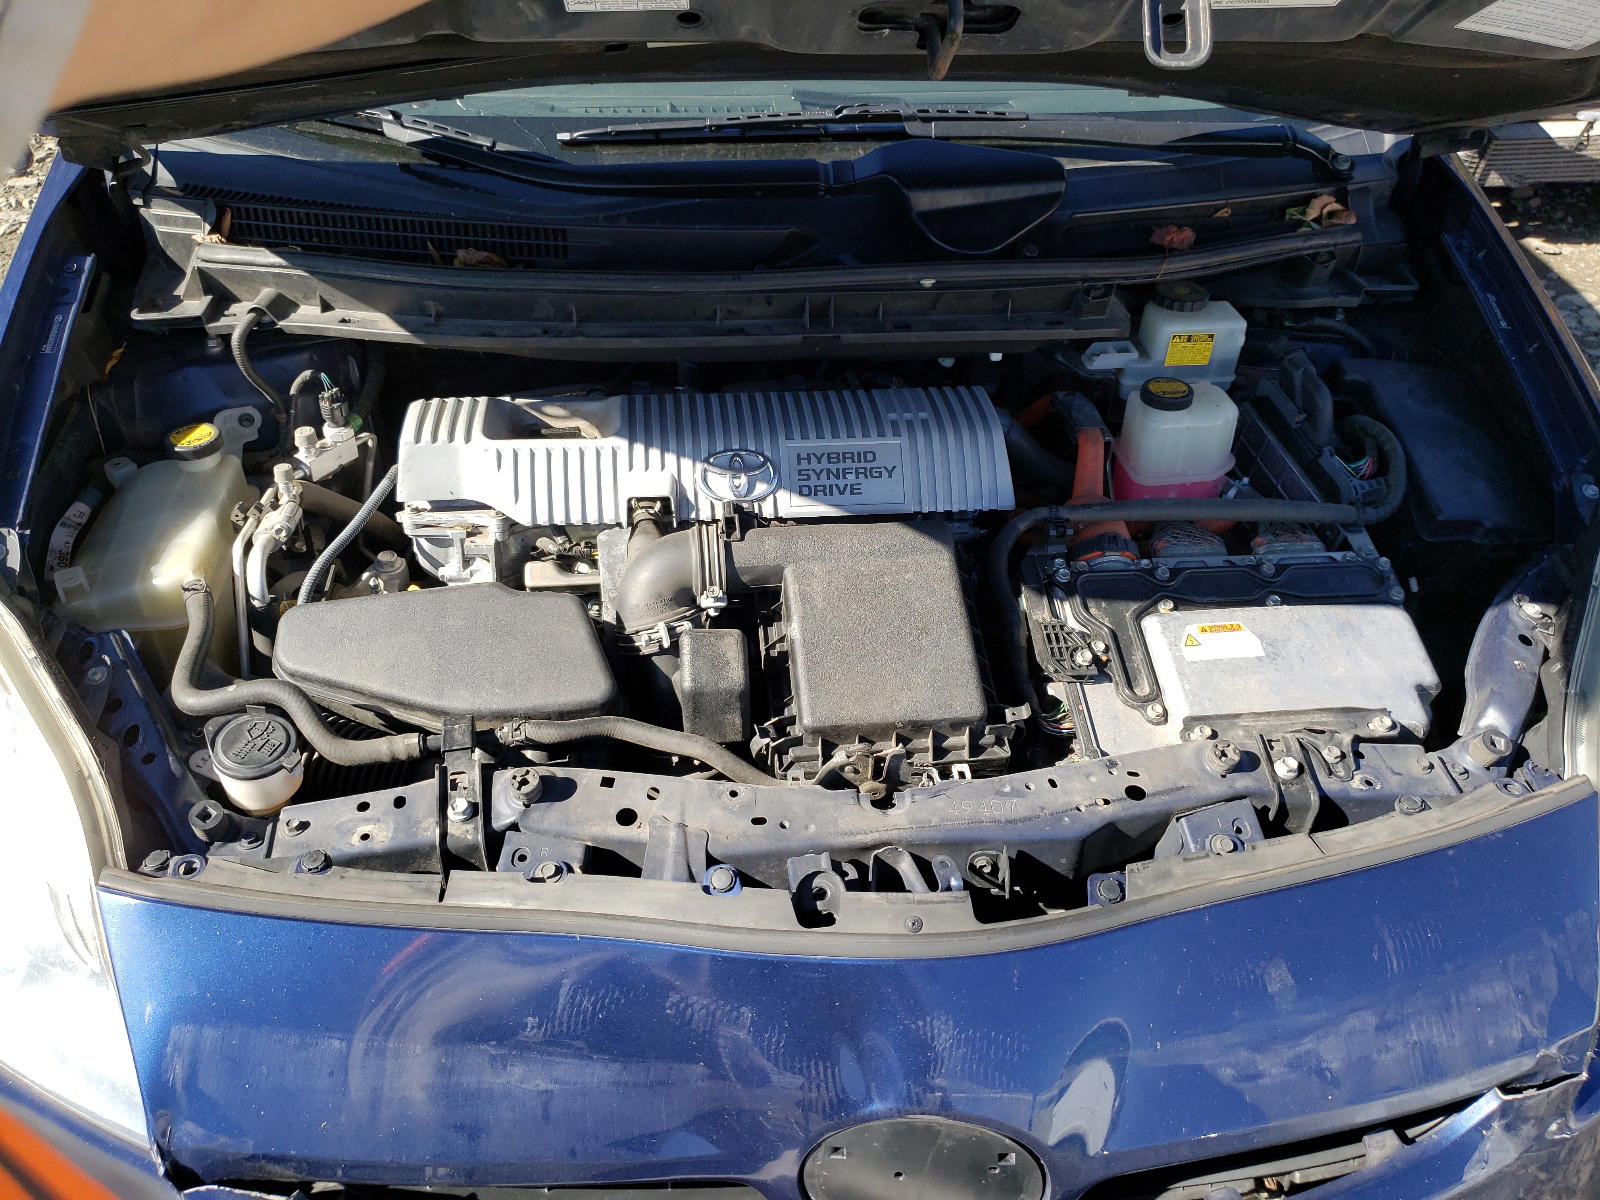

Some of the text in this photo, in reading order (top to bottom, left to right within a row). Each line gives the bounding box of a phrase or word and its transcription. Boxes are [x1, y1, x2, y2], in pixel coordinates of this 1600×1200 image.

[796, 450, 877, 466] HYBRID
[797, 465, 897, 482] SYNERGY
[798, 483, 863, 497] DRIVE
